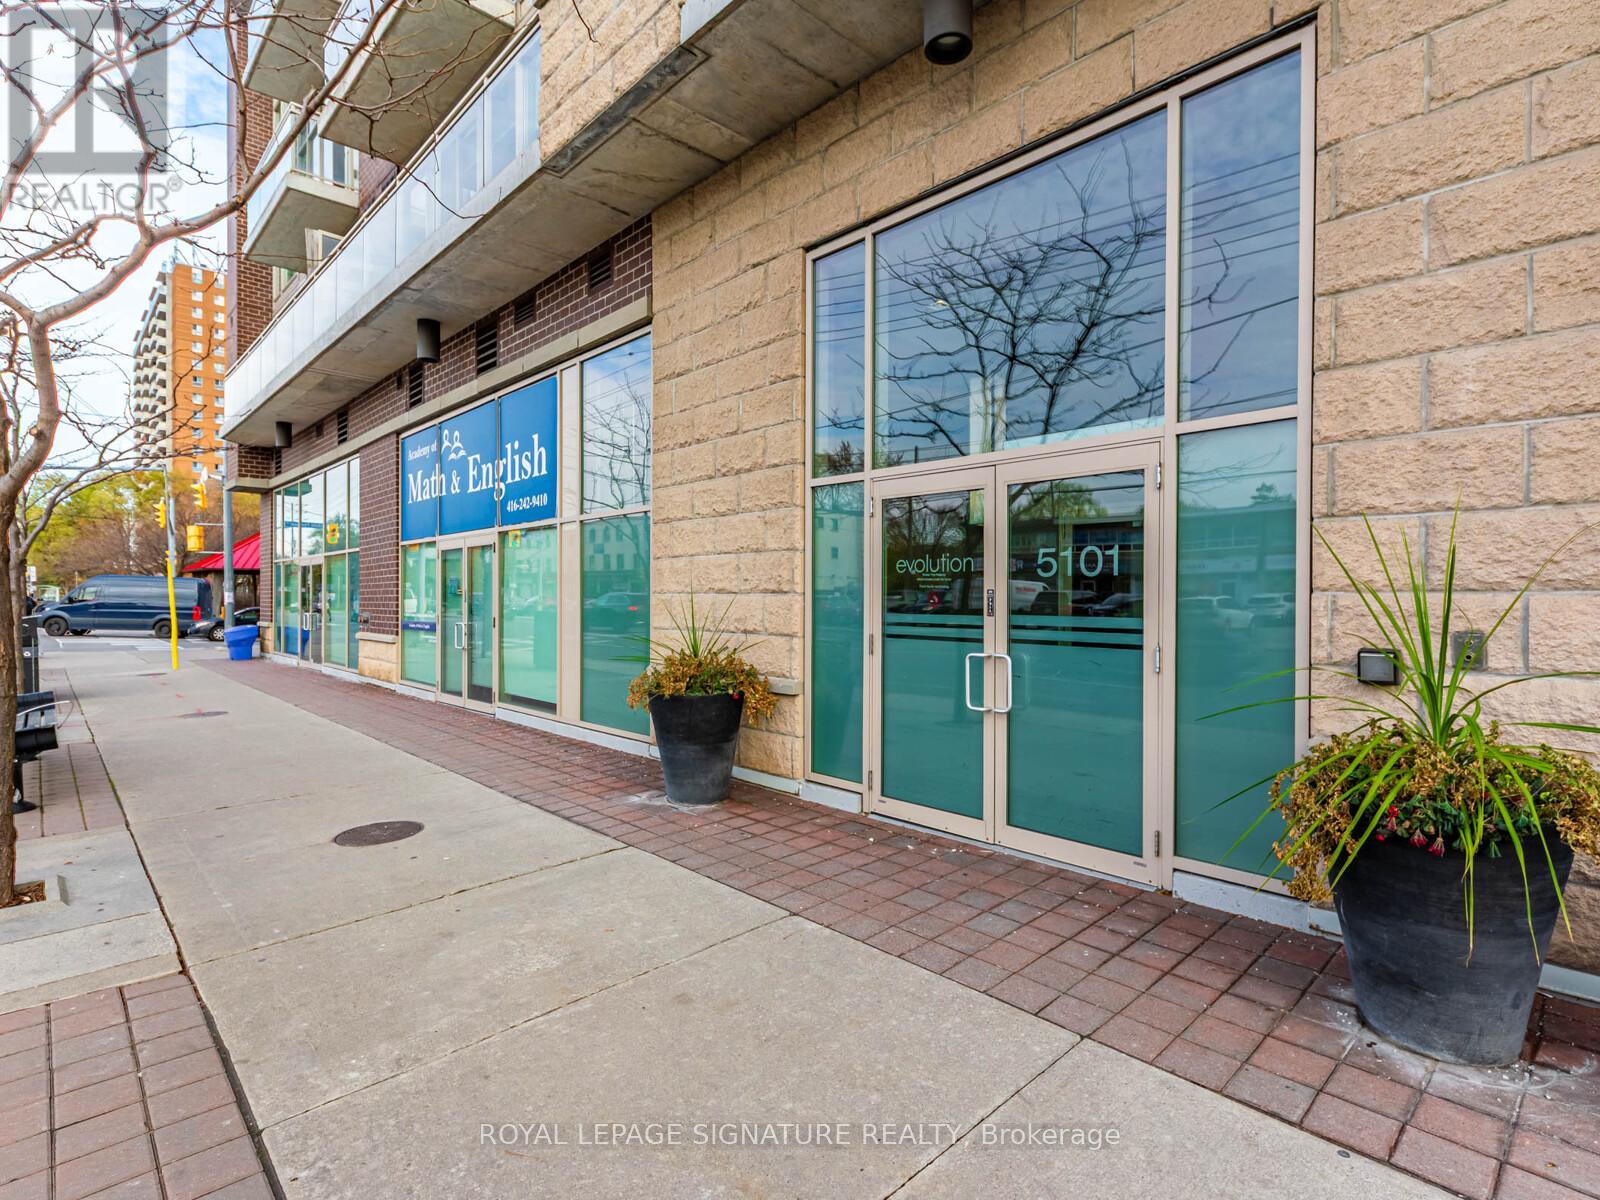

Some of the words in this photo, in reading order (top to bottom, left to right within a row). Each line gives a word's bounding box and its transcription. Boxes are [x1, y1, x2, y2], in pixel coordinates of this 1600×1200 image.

[408, 446, 430, 461] Academy
[408, 464, 447, 504] Math
[451, 470, 461, 495] &
[467, 433, 548, 501] English
[506, 493, 548, 513] 416-242-9410
[895, 553, 974, 574] evolution
[1036, 544, 1119, 578] 5101
